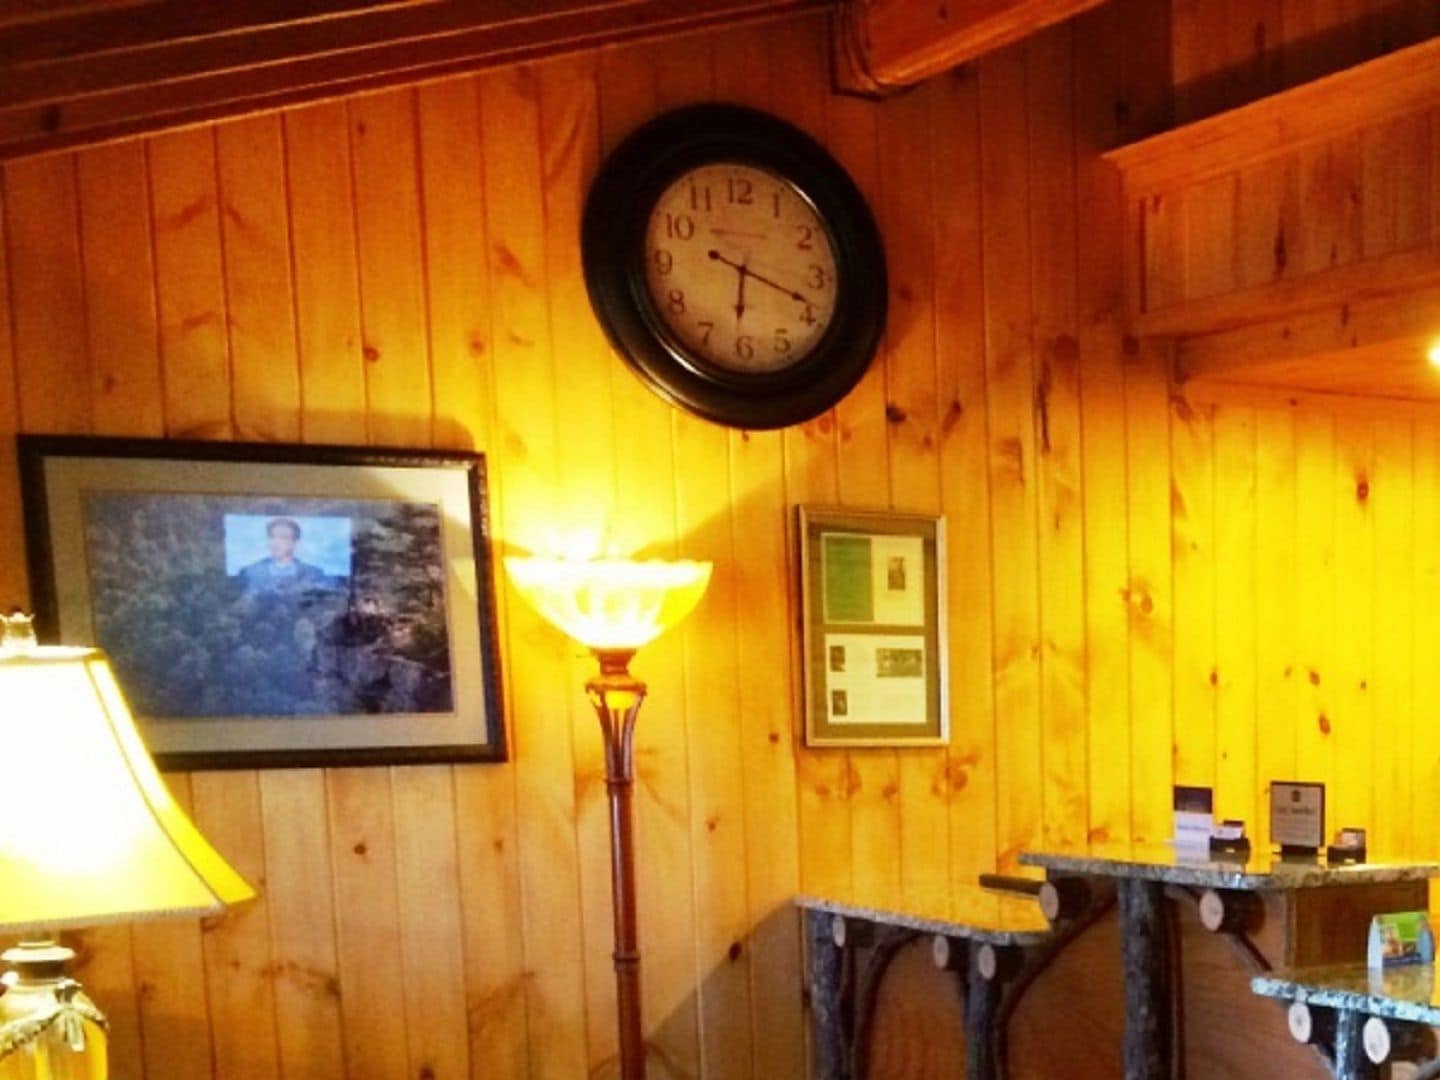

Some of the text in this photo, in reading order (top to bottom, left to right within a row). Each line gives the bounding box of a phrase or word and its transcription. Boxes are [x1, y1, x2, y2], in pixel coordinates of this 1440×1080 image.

[690, 184, 711, 212] 11
[727, 178, 753, 205] 12
[772, 193, 780, 218] 1
[665, 213, 695, 240] 10
[797, 226, 813, 250] 2
[655, 251, 673, 275] 9
[807, 265, 825, 290] 3
[668, 291, 685, 314] 8
[799, 301, 817, 327] 4
[698, 321, 714, 347] 7
[774, 328, 792, 353] 5
[735, 336, 755, 361] 6
